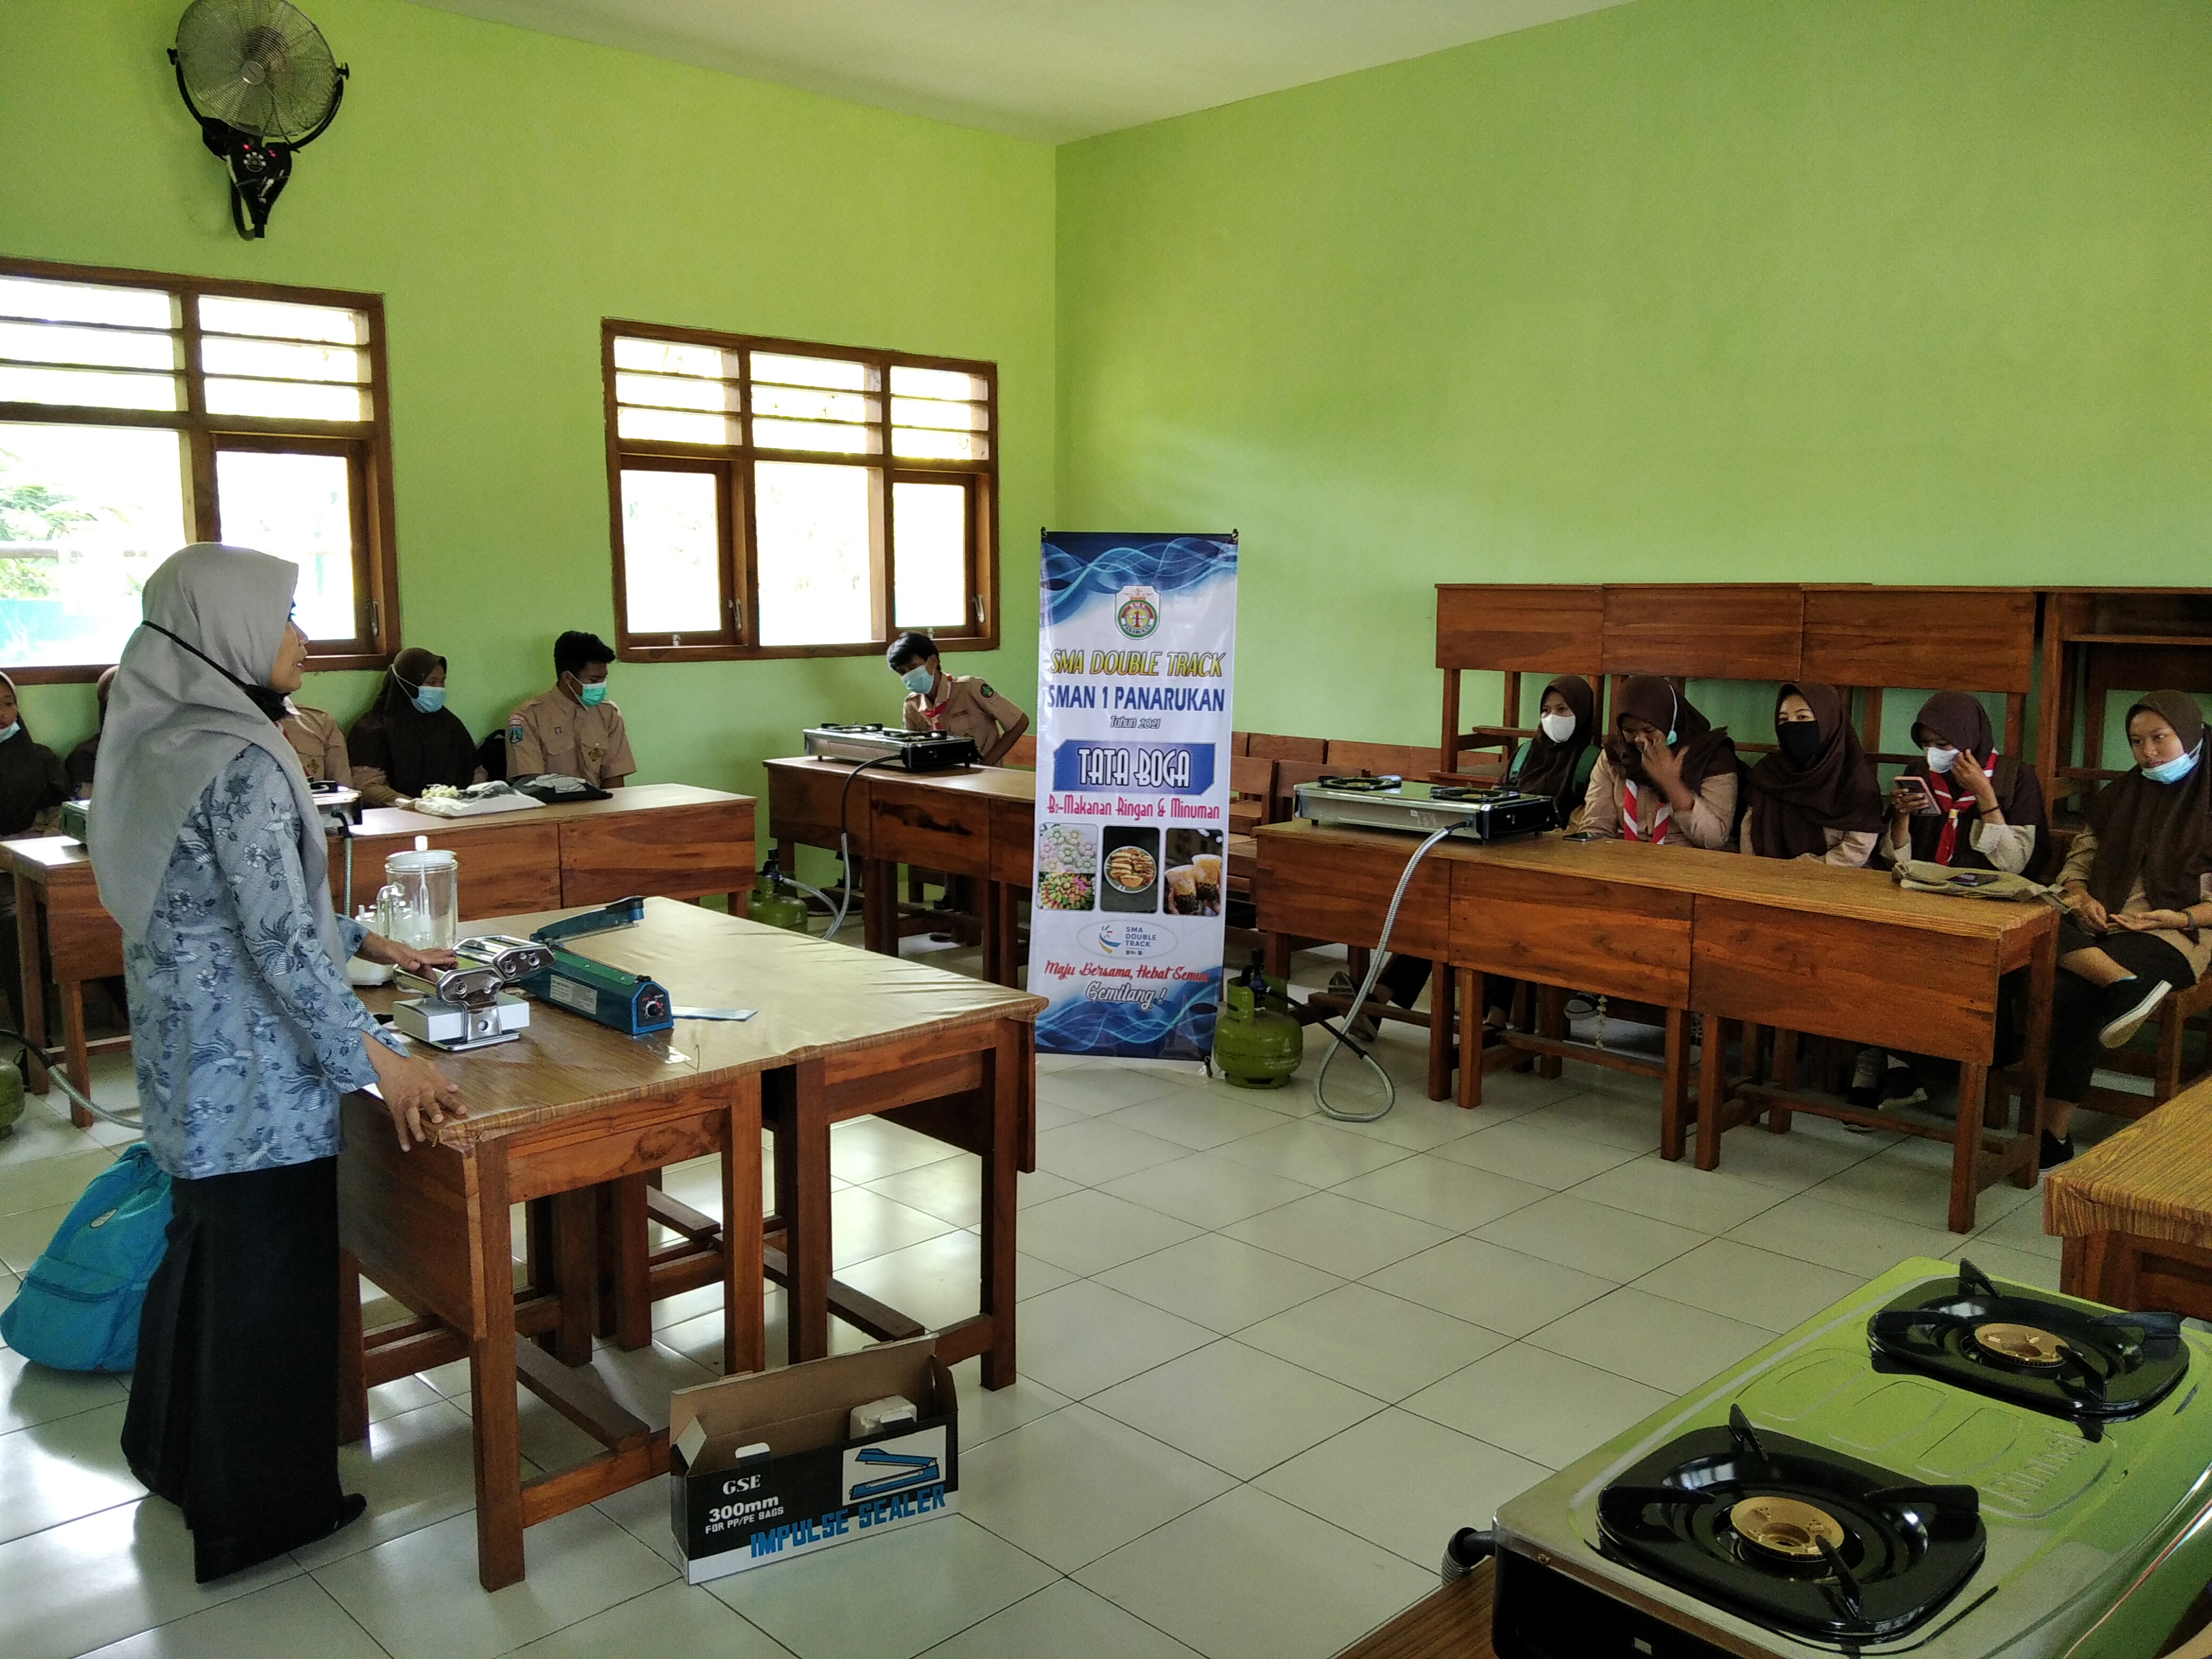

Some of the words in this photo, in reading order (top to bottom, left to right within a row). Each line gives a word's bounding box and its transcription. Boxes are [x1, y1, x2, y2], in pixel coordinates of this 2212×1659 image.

[1048, 648, 1084, 674] SMA
[1090, 651, 1163, 675] DOUBLE
[1166, 652, 1226, 677] TRACK
[1047, 685, 1096, 708] SMAN
[1102, 686, 1108, 709] 1
[1114, 686, 1225, 712] PANARUKAN
[1110, 716, 1136, 728] Tahun
[1137, 718, 1161, 729] 2021
[1078, 748, 1130, 786] TATA
[1133, 748, 1191, 788] BOGA
[1115, 796, 1153, 821] Ringan
[1156, 797, 1166, 817] &
[1170, 798, 1220, 819] Minuman
[1044, 960, 1076, 980] Maju
[1079, 962, 1133, 980] Bersama,
[1136, 964, 1174, 979] Hebat
[723, 1474, 761, 1495] GSE
[705, 1522, 724, 1534] FOR
[727, 1514, 755, 1529] PP/PE
[758, 1506, 784, 1520] BAGS
[708, 1496, 779, 1522] 300mm
[751, 1508, 849, 1558] IMPULSE
[859, 1484, 946, 1529] SEALER
